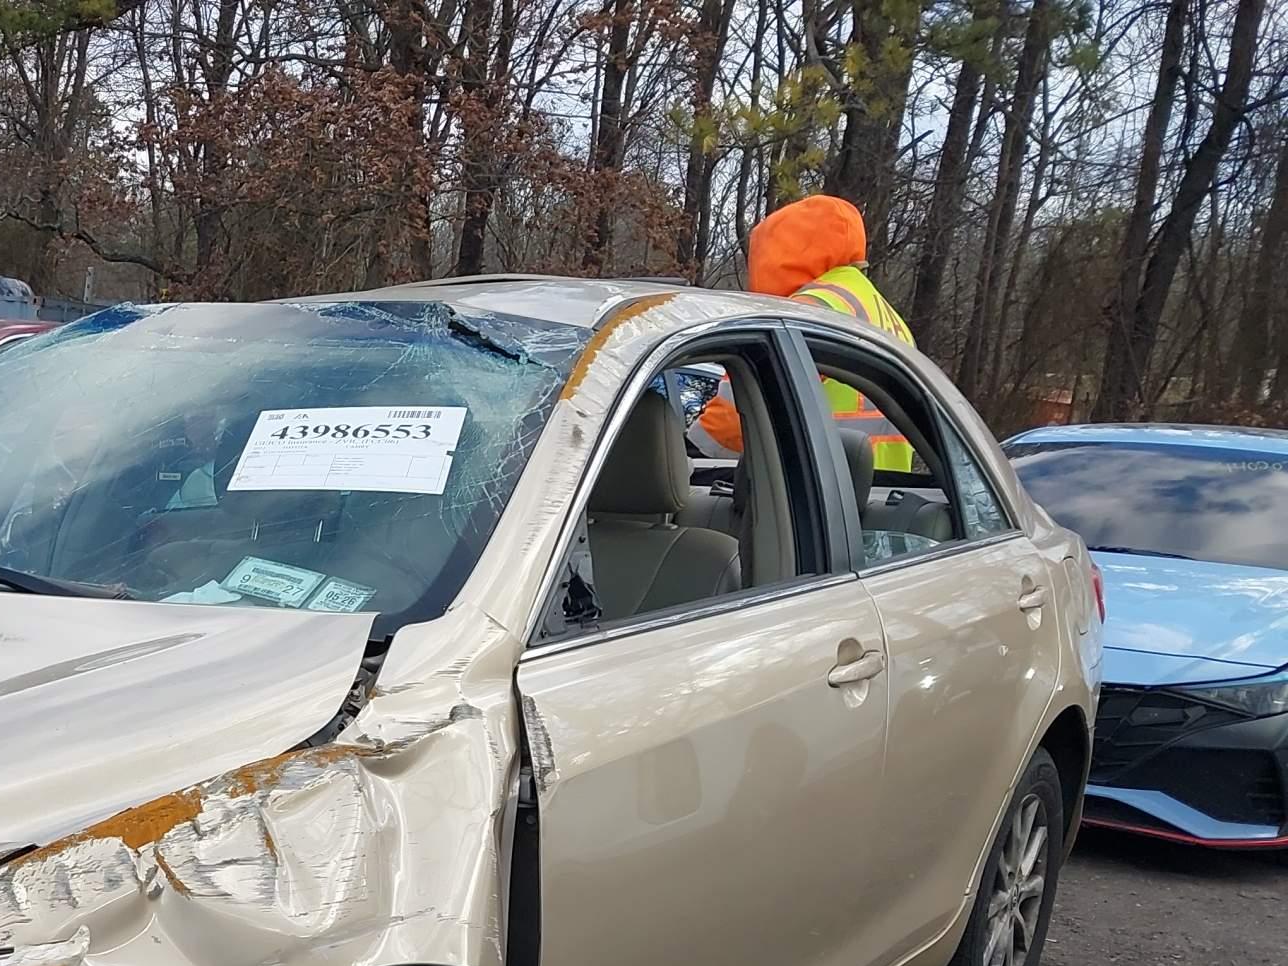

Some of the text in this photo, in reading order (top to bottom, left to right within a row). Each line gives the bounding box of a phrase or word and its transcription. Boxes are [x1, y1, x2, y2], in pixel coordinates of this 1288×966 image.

[270, 424, 431, 439] 43986553
[240, 574, 252, 584] 9
[281, 584, 305, 596] 27
[325, 590, 340, 601] 05
[341, 595, 357, 606] 26
